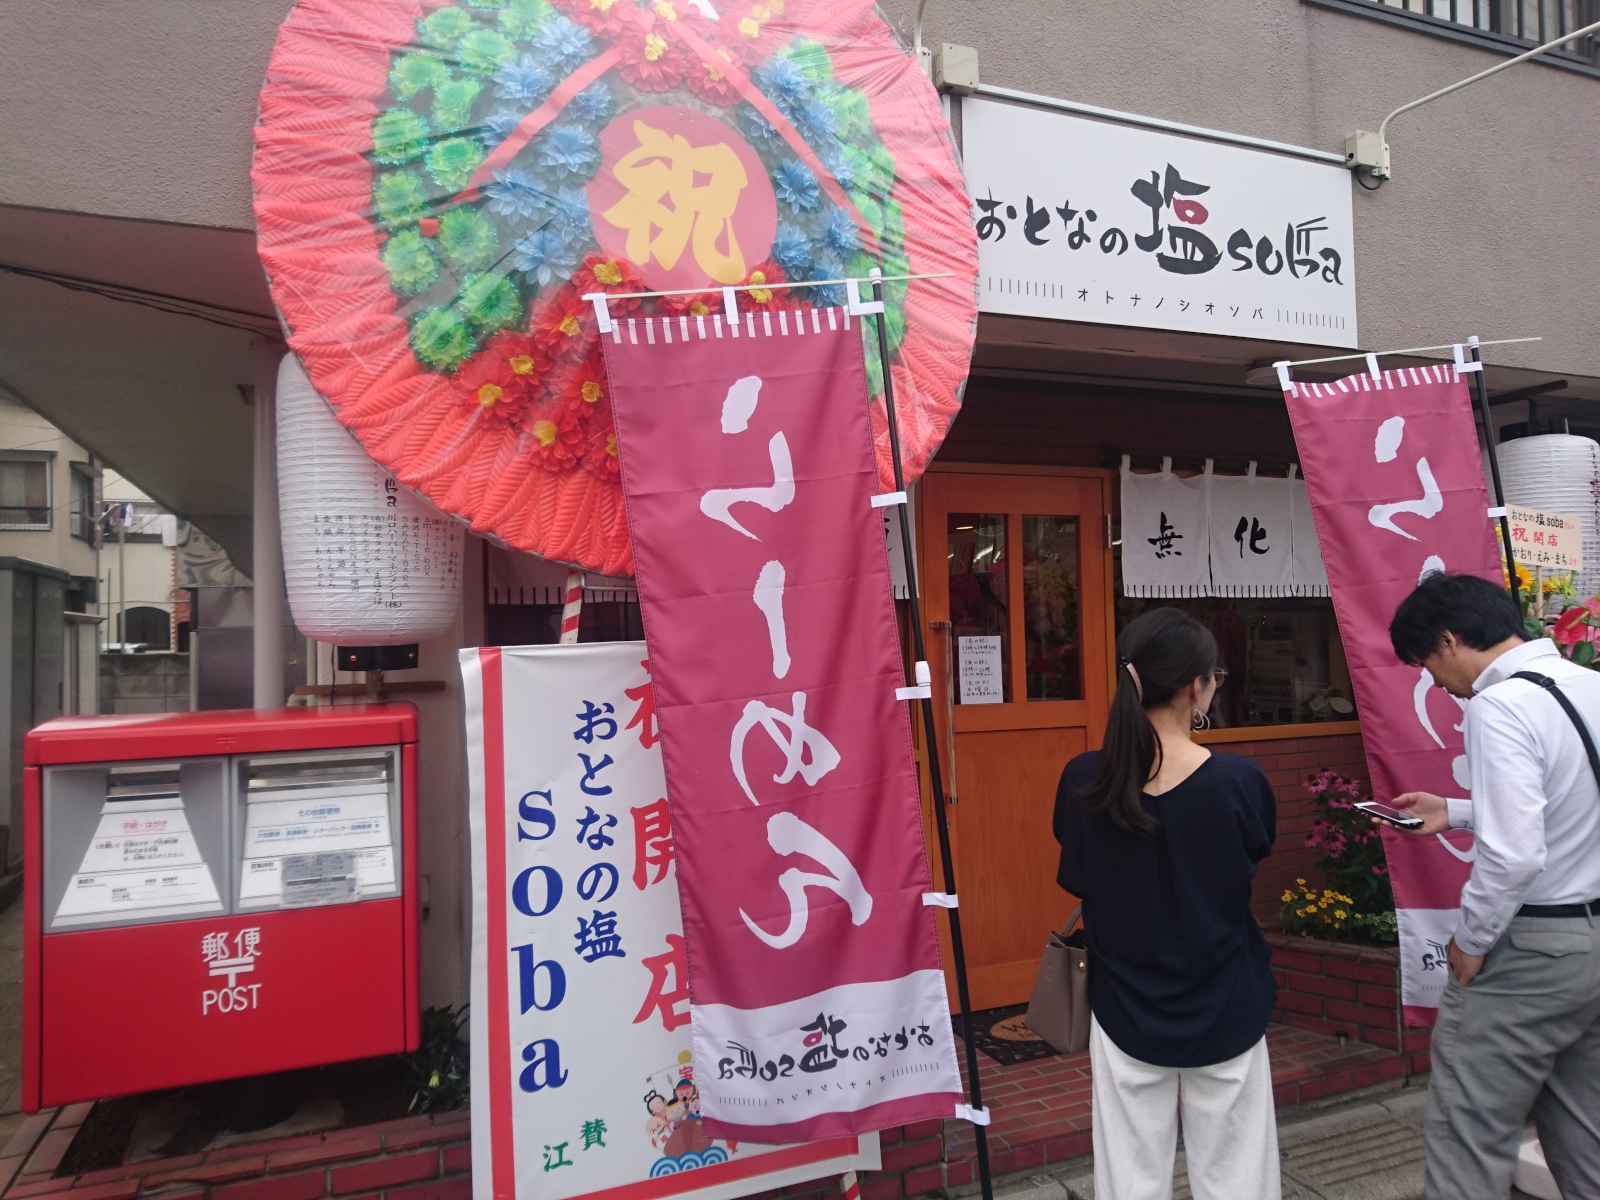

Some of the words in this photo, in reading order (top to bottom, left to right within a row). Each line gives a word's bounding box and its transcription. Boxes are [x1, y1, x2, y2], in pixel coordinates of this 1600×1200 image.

[602, 119, 748, 284] 祝
[1078, 287, 1264, 320] オトナノシオソバ
[122, 821, 168, 831] 手紙・はがき
[573, 700, 627, 964] おとなの塩
[202, 927, 262, 963] 郵便
[203, 984, 263, 1016] POST
